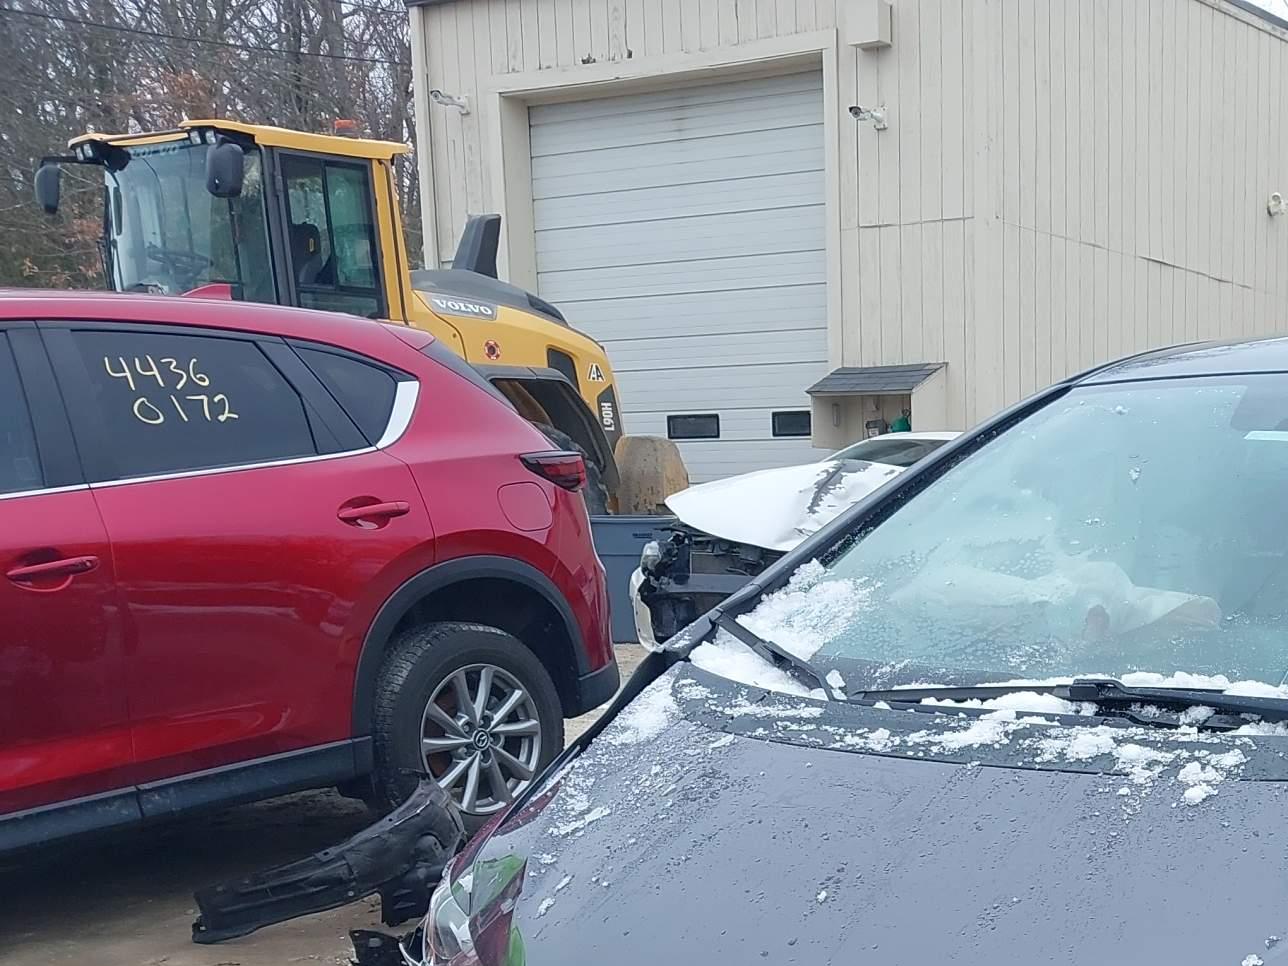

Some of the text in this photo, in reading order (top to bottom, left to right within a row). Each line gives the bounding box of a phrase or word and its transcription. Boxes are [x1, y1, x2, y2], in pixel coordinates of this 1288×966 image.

[432, 298, 492, 316] VOLVO
[103, 355, 210, 392] 4436
[133, 393, 240, 426] 0172
[601, 402, 615, 431] L90H
